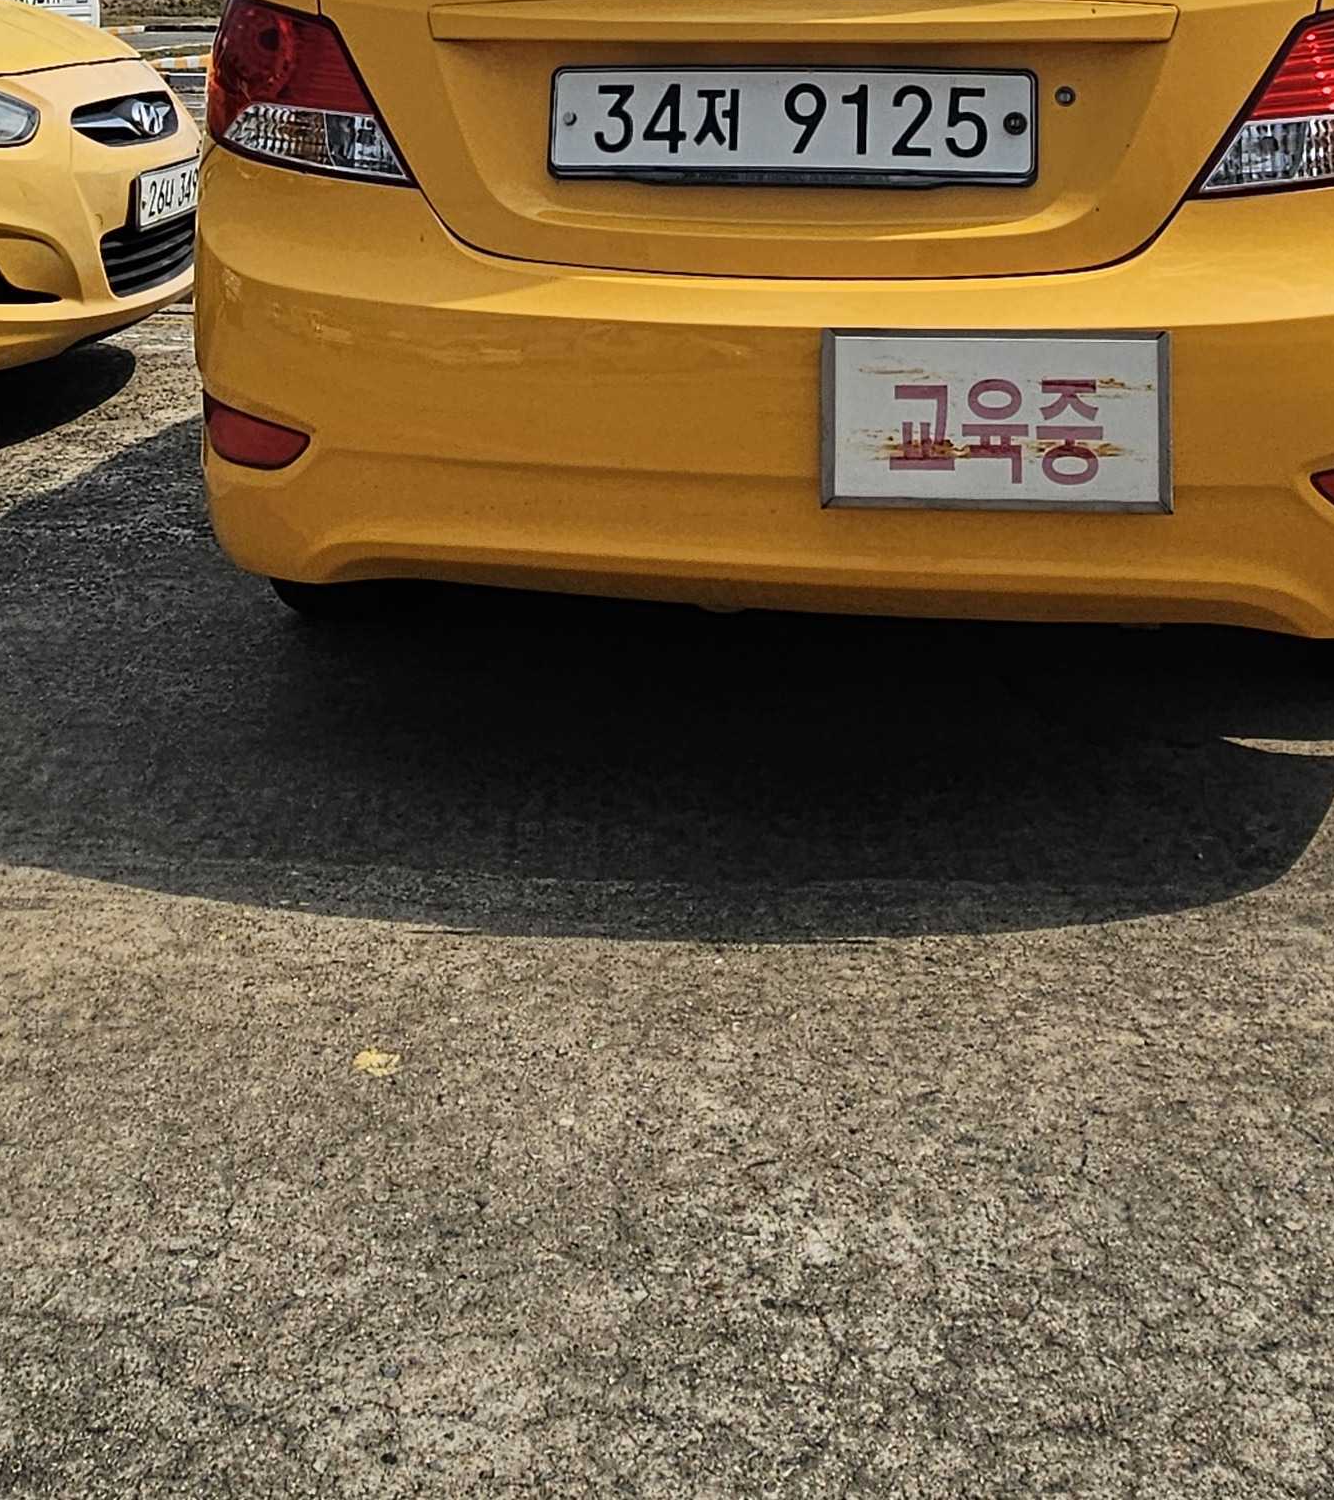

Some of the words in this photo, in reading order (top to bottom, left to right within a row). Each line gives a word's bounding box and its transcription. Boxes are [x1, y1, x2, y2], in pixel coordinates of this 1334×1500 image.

[593, 83, 740, 154] 34저
[784, 83, 989, 159] 9125
[889, 378, 1104, 486] 교육중
